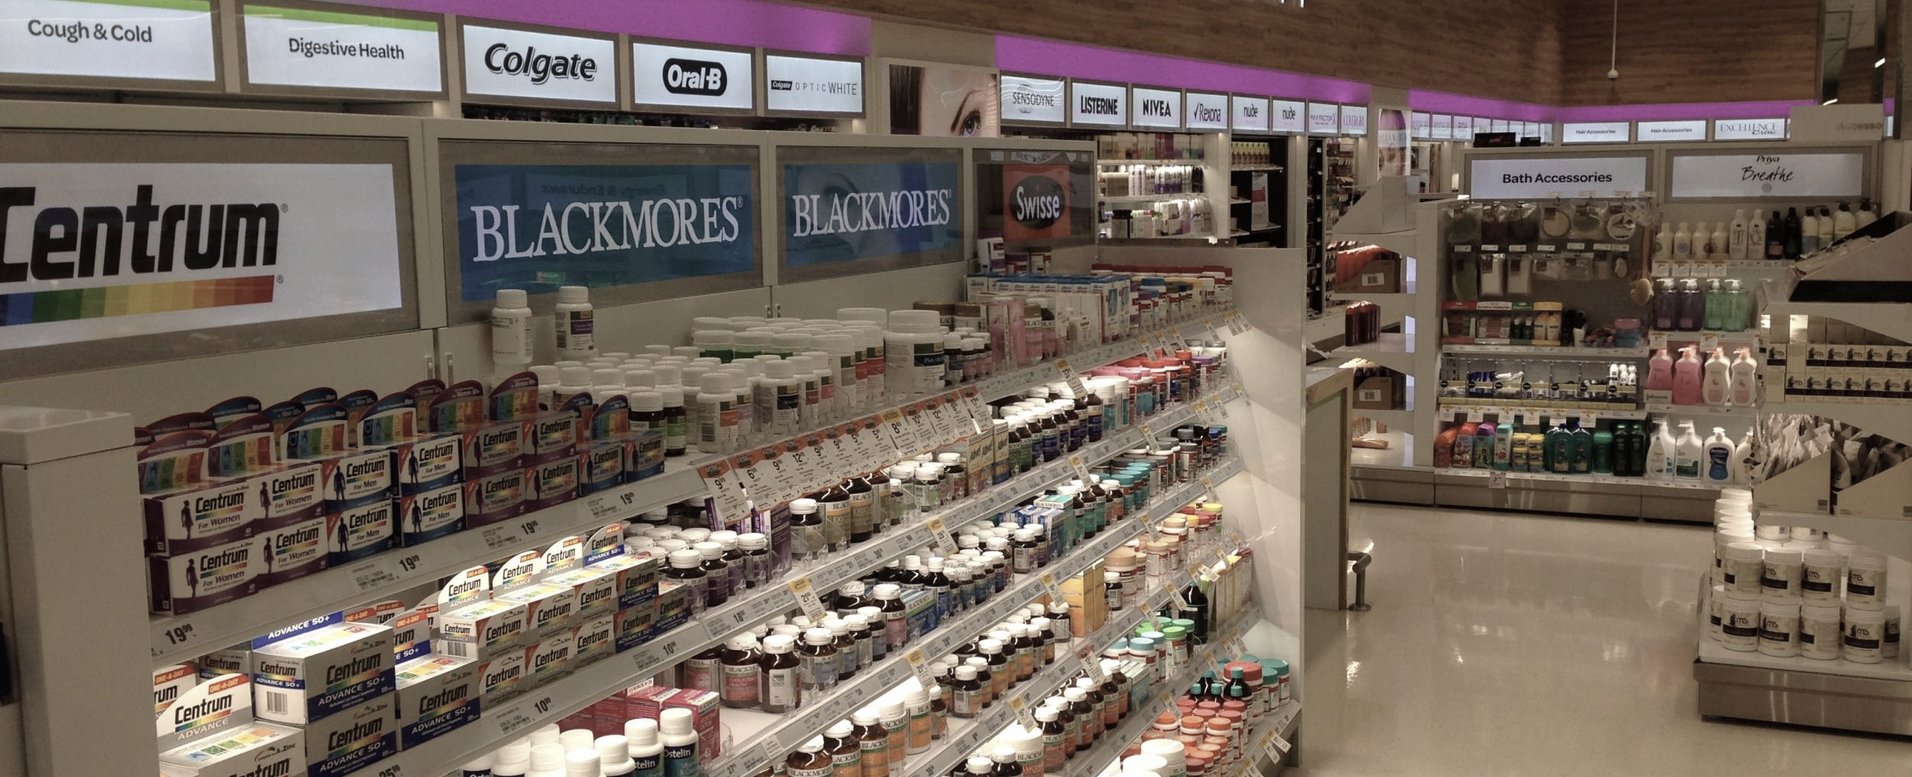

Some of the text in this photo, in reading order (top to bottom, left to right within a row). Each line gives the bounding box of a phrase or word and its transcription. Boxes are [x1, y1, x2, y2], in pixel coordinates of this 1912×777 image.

[28, 19, 152, 43] Cough & Cold
[288, 37, 405, 60] Digestive Health
[484, 42, 597, 83] Colgate
[667, 62, 722, 91] Oral-B
[772, 80, 857, 96] Colgate OPTIC WHITE
[1012, 91, 1055, 107] SENSODYNE
[1080, 94, 1118, 116] LISTERINE
[1143, 98, 1171, 117] NIVEA
[1199, 103, 1222, 122] Rexona
[1243, 103, 1258, 118] nude
[1282, 106, 1296, 120] nude
[1503, 171, 1613, 184] Bath Accessories
[1741, 165, 1794, 182] Breathe
[792, 187, 950, 237] BLACKMORES
[1016, 186, 1060, 221] Swisse
[0, 184, 281, 283] Centrum
[470, 196, 740, 262] BLACKMORES
[484, 430, 517, 446] Centrum
[420, 445, 453, 461] Centrum
[346, 460, 385, 477] Centrum
[272, 474, 315, 494] Centrum
[486, 477, 520, 493] Centrum
[195, 492, 244, 513] Centrum
[286, 495, 313, 507] Women
[422, 493, 457, 511] Centrum
[210, 513, 241, 526] Women
[349, 509, 387, 528] Centrum
[276, 528, 319, 549] Centrum
[592, 535, 618, 550] Centrum
[201, 549, 248, 571] Centrum
[289, 548, 316, 561] Women
[546, 548, 576, 564] Centrum
[215, 570, 244, 584] Women
[502, 563, 534, 580] Centrum
[449, 579, 481, 597] Centrum
[581, 586, 612, 606] Centrum
[538, 603, 571, 623] Centrum
[268, 615, 330, 640] ADVANCE 50+
[445, 624, 471, 634] Centrum
[486, 619, 521, 641] Centrum
[578, 629, 609, 649] Centrum
[205, 655, 240, 670] Centrum
[535, 646, 569, 668] Centrum
[260, 661, 296, 677] Centrum
[326, 653, 381, 685] Centrum
[486, 665, 520, 688] Centrum
[209, 678, 239, 694] ONE-A-DAY
[256, 677, 283, 687] ADVANCE
[318, 684, 364, 706] ADVANCE
[366, 676, 386, 688] 50+
[419, 684, 468, 714] Centrum
[175, 694, 232, 725] Centrum
[178, 717, 230, 741] ADVANCE
[411, 712, 452, 735] ADVANCE
[454, 705, 472, 717] 50+
[328, 717, 383, 751] Centrum
[319, 740, 387, 773] ADVANCE 50+
[635, 759, 656, 771] stelin
[229, 758, 290, 777] trum
